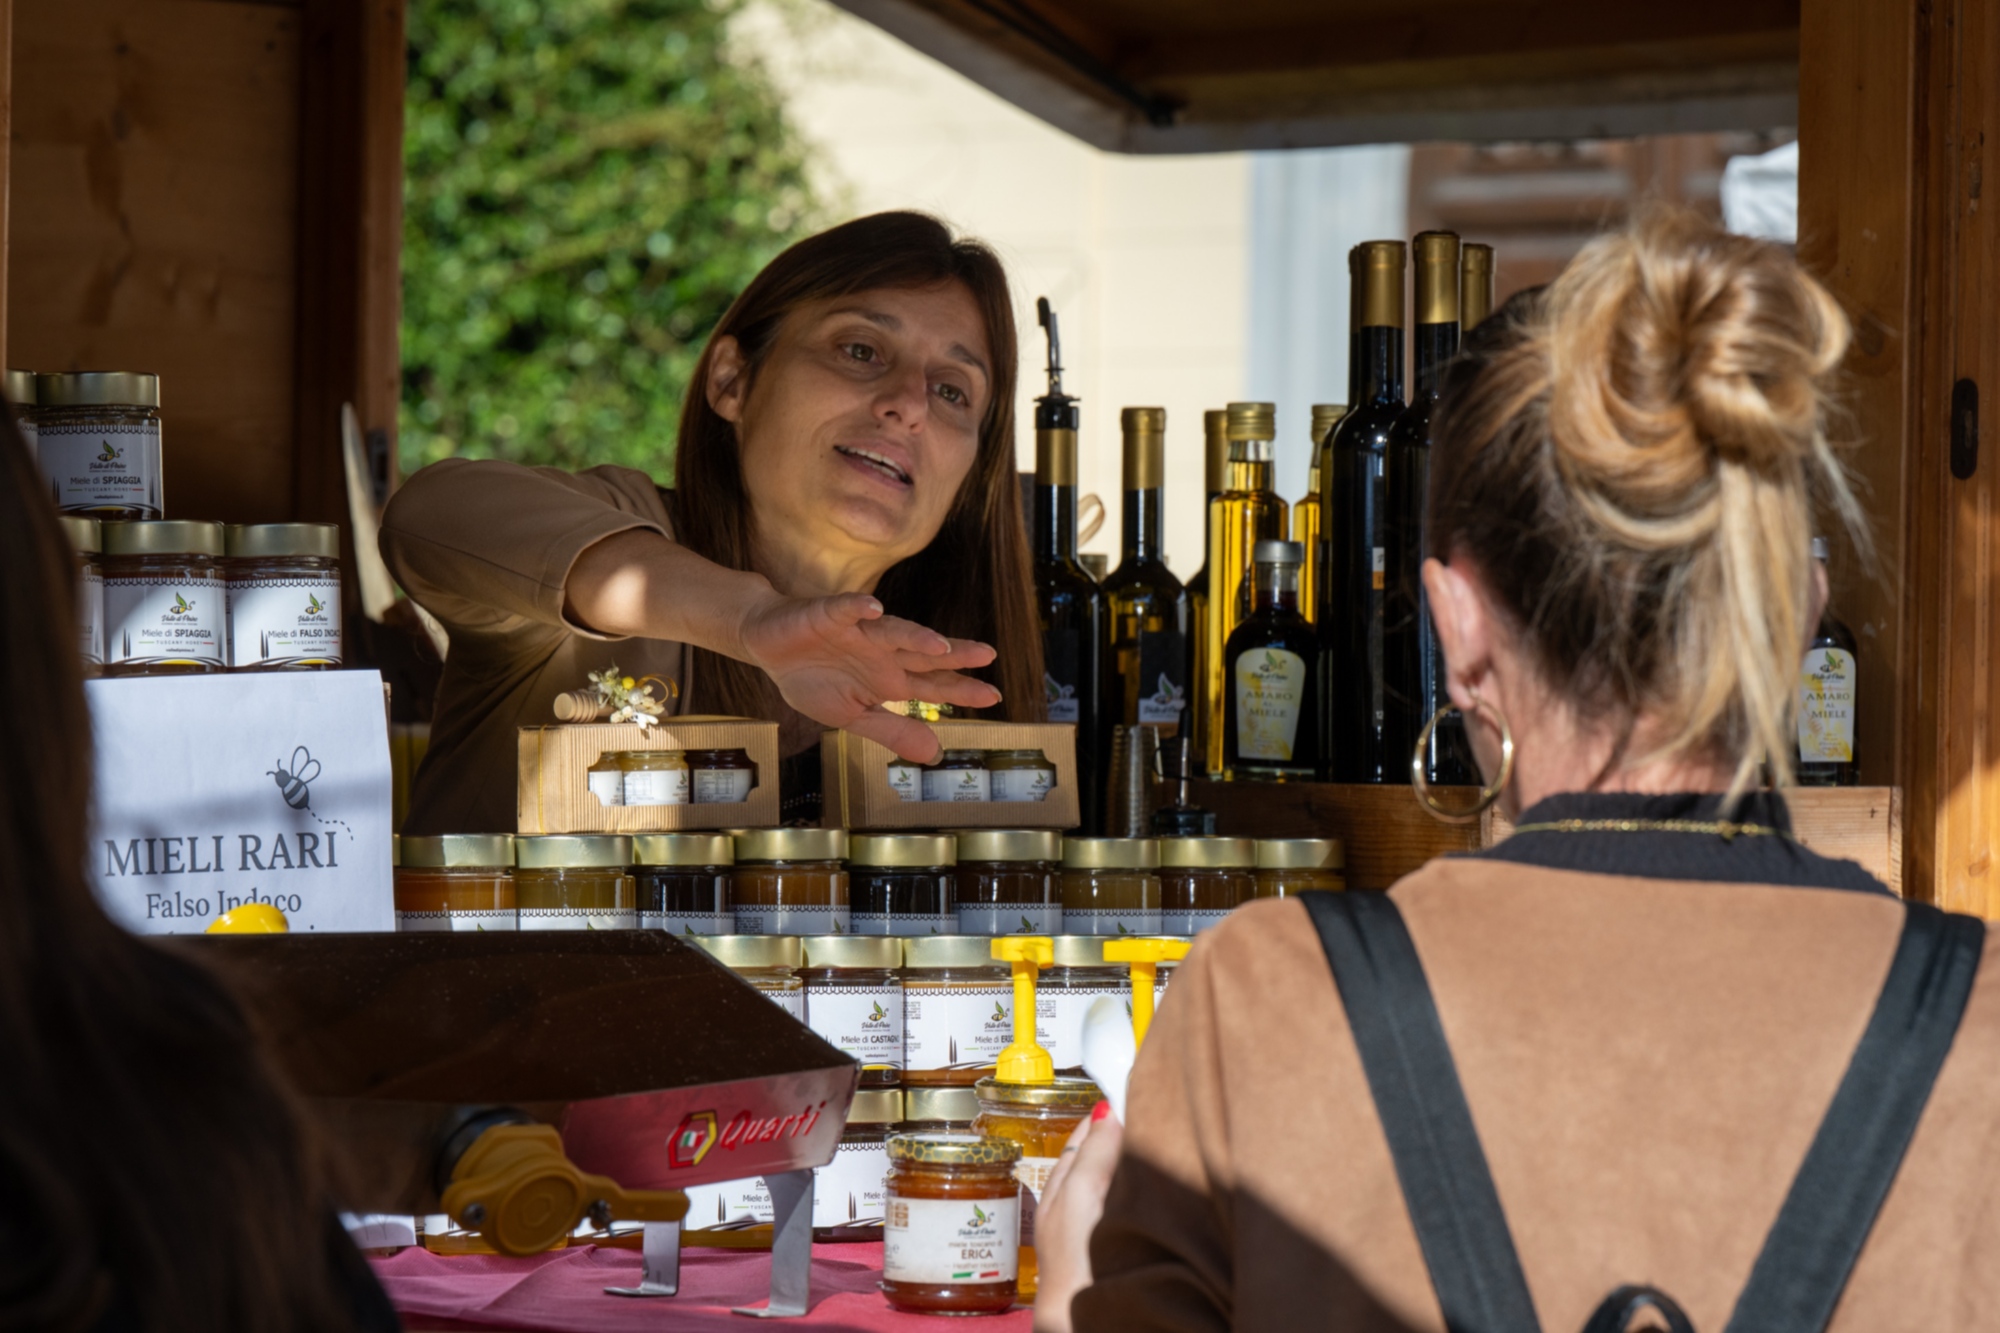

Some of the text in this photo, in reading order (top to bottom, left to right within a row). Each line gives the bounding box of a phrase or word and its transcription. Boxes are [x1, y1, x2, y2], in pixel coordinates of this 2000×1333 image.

[70, 476, 142, 485] Miele di SPIAGGIA
[142, 629, 212, 638] Miele di SPIAGGIA
[268, 630, 288, 638] Miele
[290, 629, 297, 638] di
[300, 628, 323, 638] FALSO
[1246, 690, 1293, 701] AMARO
[1806, 692, 1850, 701] AMARO
[1248, 708, 1287, 718] MIELE
[1812, 710, 1847, 720] MIELE
[104, 830, 338, 877] MIELI RARI
[145, 890, 210, 919] Falso
[841, 1036, 860, 1044] Miele
[975, 1034, 1014, 1044] Miele di ERIC
[719, 1100, 827, 1151] Quarti
[742, 1194, 771, 1202] Miele di
[864, 1192, 881, 1200] Miele
[961, 1248, 994, 1260] ERICA
